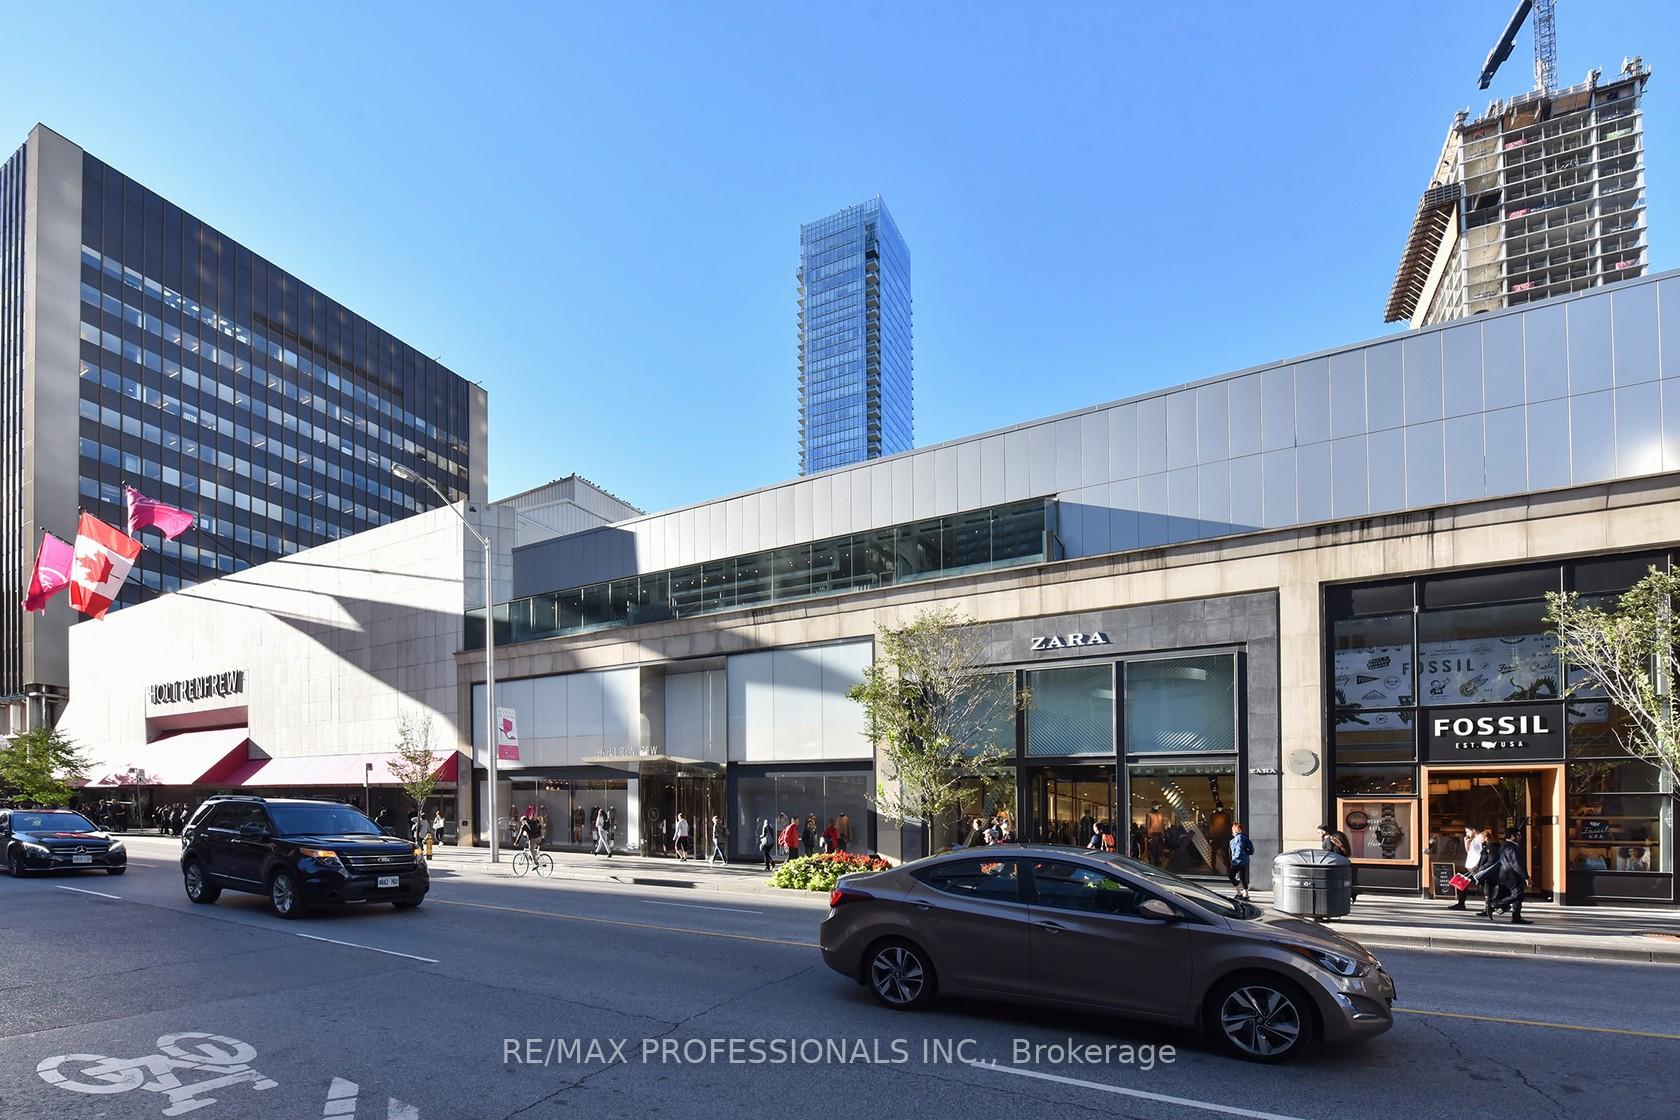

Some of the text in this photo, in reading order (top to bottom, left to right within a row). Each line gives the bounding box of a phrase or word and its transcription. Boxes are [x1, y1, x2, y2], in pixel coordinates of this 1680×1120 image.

[1031, 632, 1108, 651] ZARA
[181, 670, 244, 703] RENFREW
[1434, 715, 1549, 737] FOSSIL
